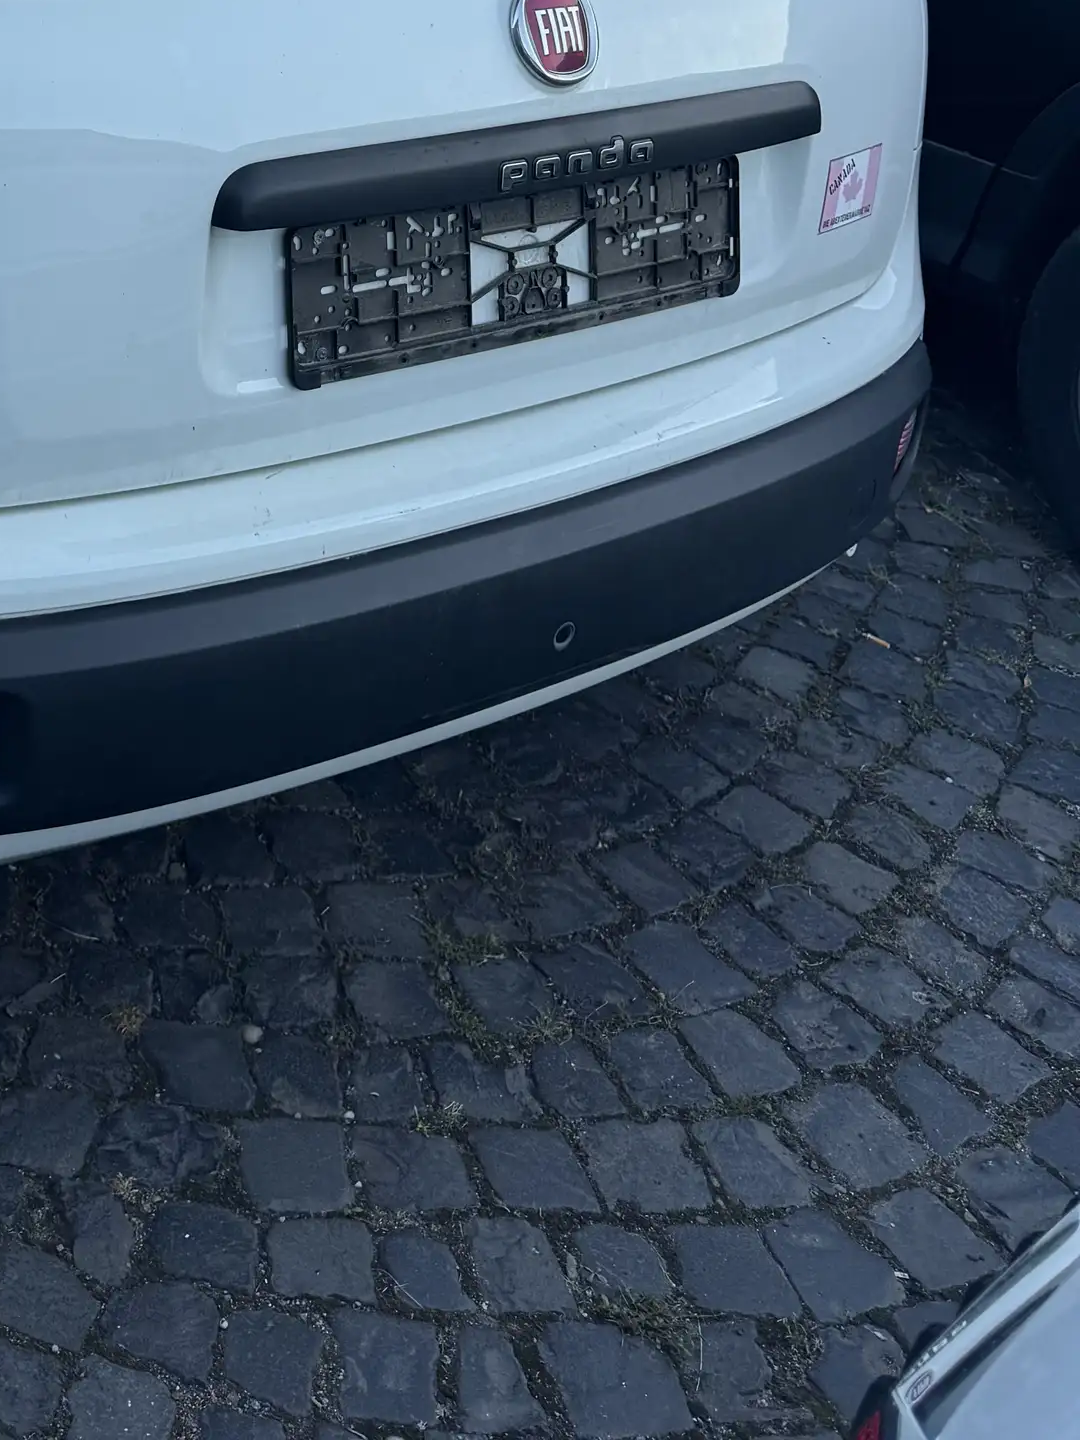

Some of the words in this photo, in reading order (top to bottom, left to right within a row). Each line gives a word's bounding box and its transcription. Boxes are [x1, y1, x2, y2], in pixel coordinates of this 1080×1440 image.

[534, 5, 584, 56] FIAT
[499, 135, 654, 194] panda
[829, 159, 856, 195] CANADA
